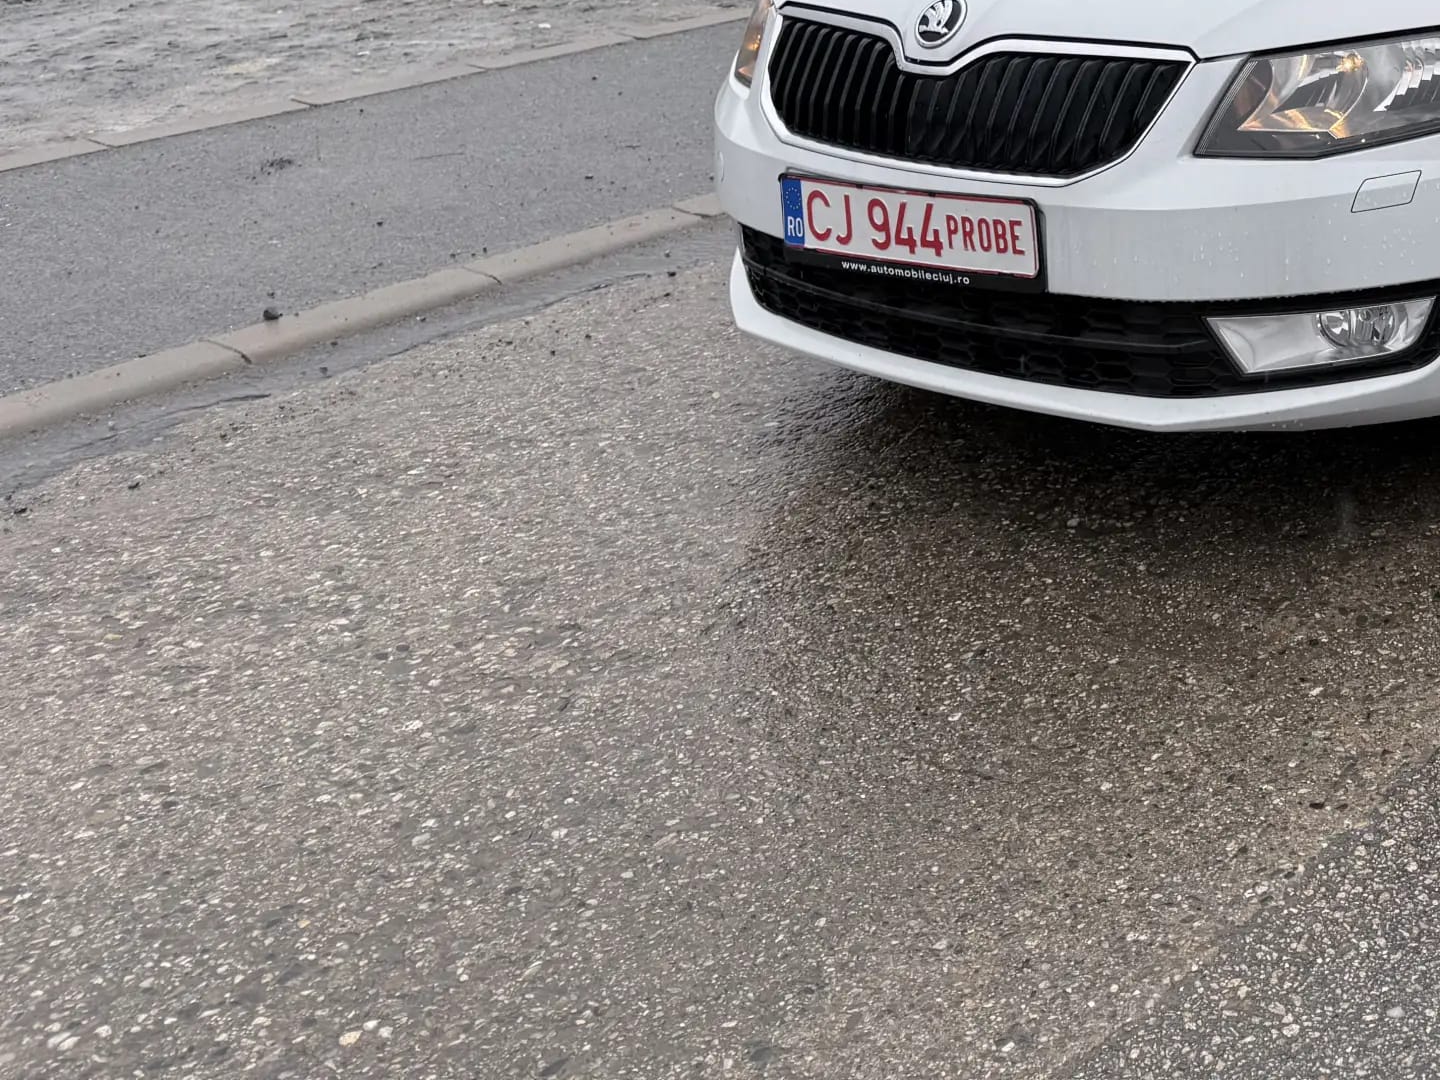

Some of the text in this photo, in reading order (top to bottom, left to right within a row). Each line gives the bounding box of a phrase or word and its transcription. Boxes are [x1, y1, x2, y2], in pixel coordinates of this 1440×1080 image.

[787, 216, 803, 238] RO
[806, 189, 1026, 257] CJ 944 PROBE
[841, 260, 970, 285] www.automobilecluj.ro
